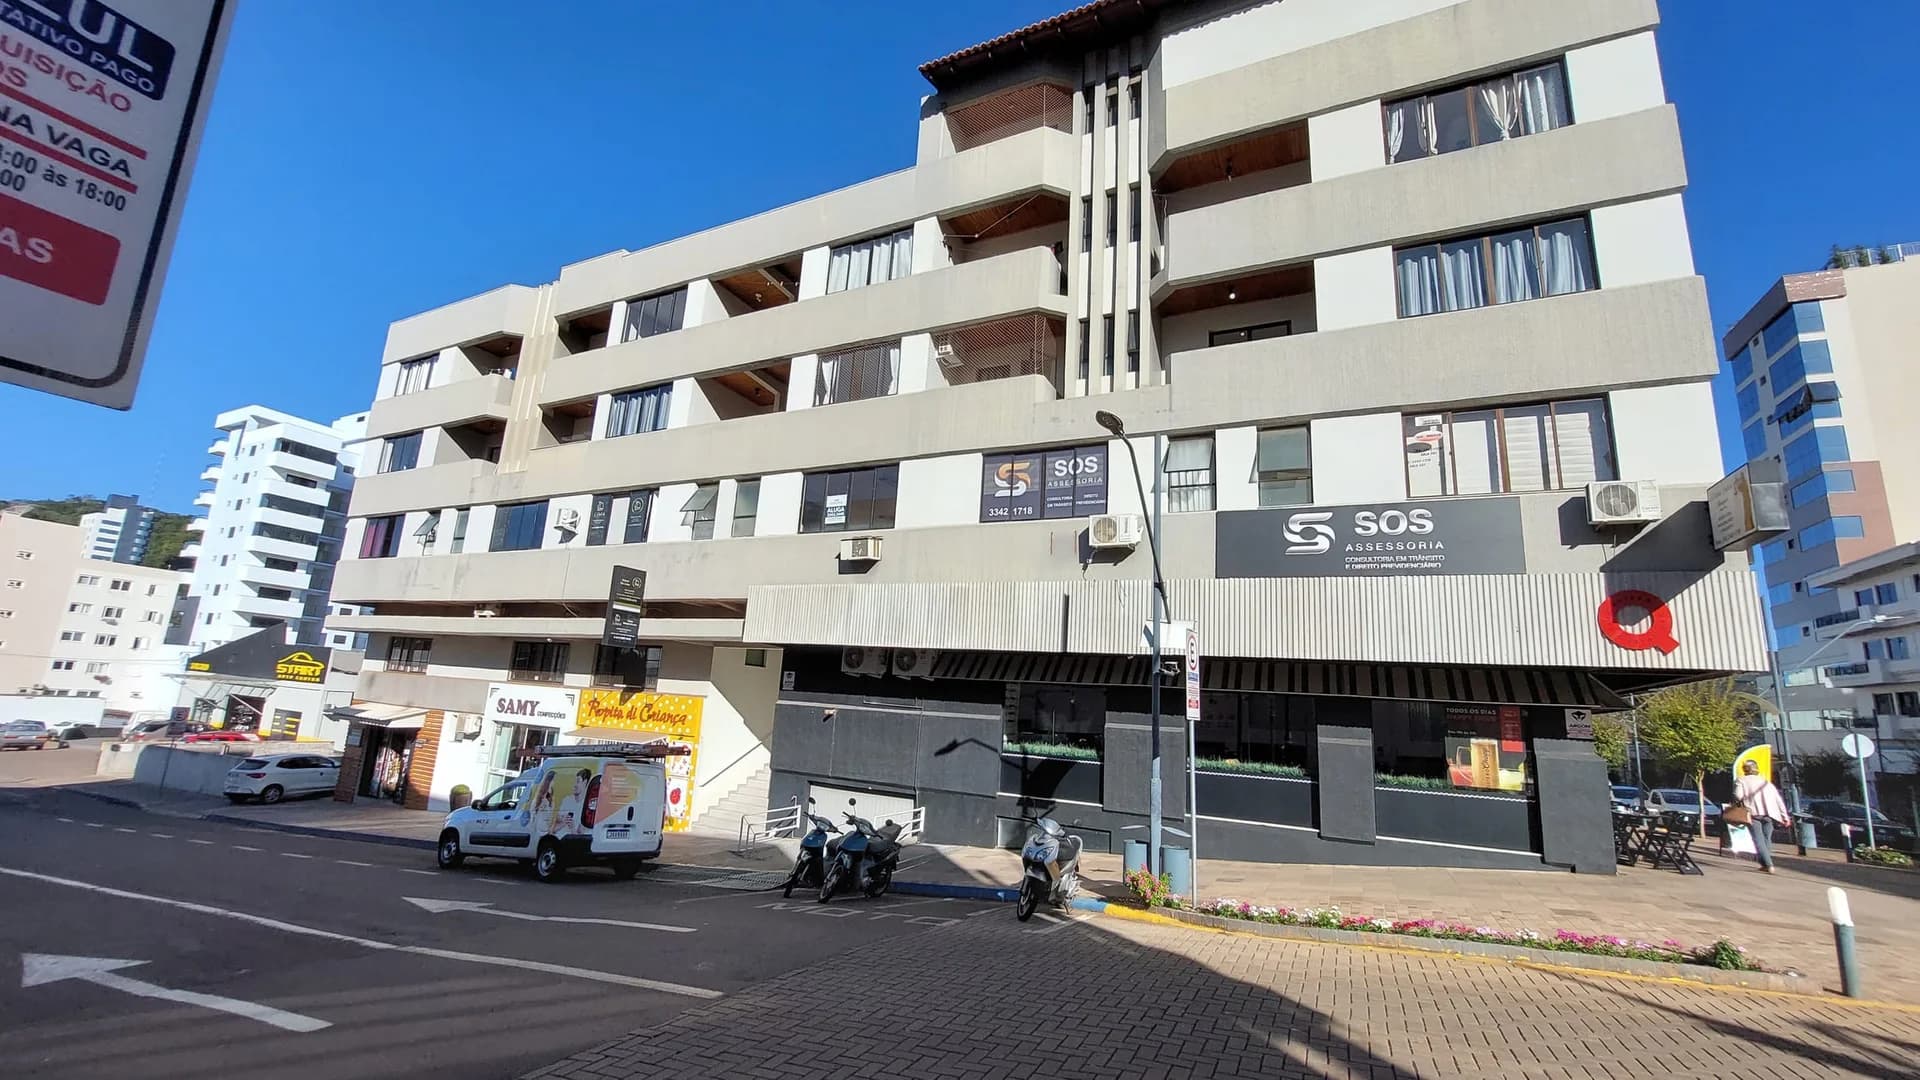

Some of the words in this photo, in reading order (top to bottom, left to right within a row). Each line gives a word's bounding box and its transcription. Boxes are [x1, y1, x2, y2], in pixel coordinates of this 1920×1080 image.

[0, 61, 28, 87] S
[90, 50, 155, 93] PAGO
[47, 124, 131, 178] VAGA
[0, 143, 37, 174] :00
[42, 164, 68, 187] às
[75, 178, 126, 211] 18:00
[1054, 456, 1098, 477] SOS
[1047, 477, 1103, 488] ASSESSORIA
[988, 507, 1009, 517] 3342
[1012, 506, 1033, 515] 1718
[1353, 508, 1435, 537] SOS
[1344, 541, 1445, 552] ASSESSORIA
[276, 664, 322, 677] START
[496, 697, 540, 717] SAMY
